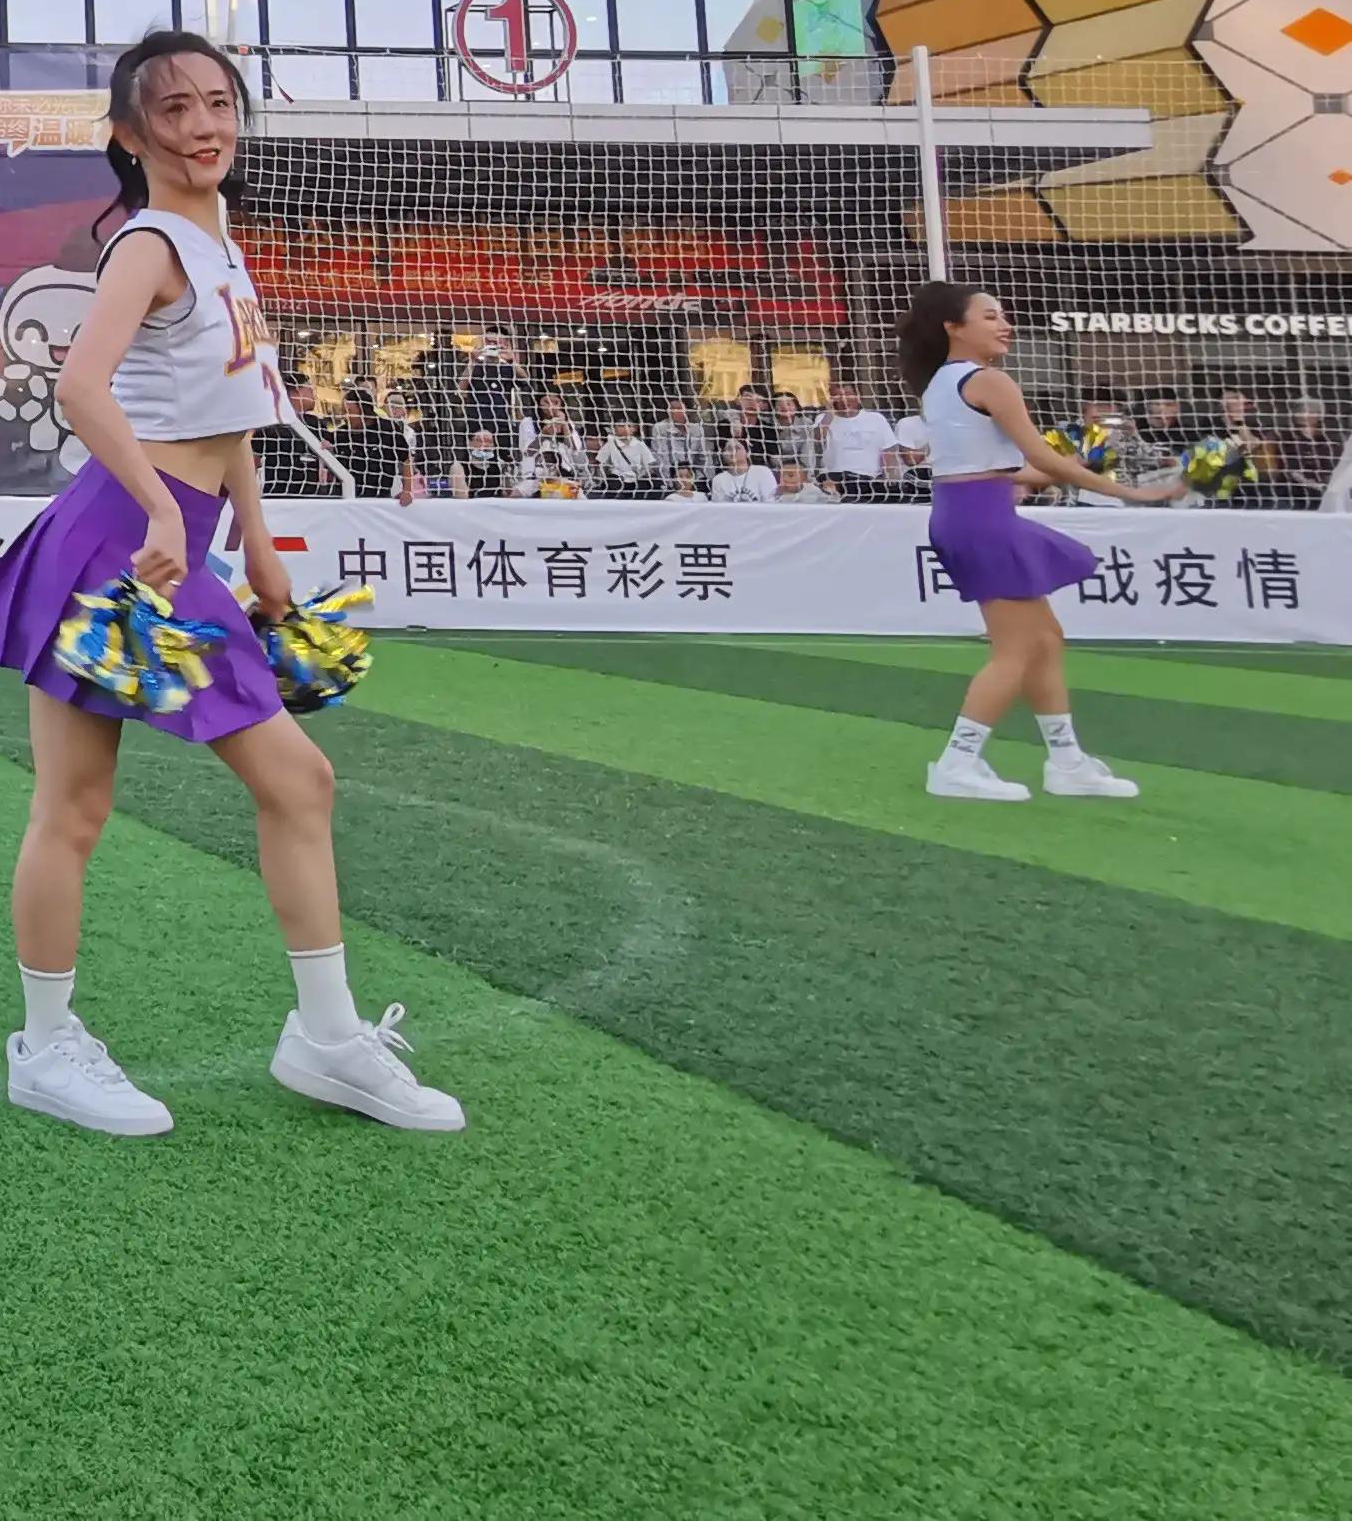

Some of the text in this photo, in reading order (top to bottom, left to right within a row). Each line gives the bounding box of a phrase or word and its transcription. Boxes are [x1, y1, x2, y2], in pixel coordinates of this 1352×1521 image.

[1050, 311, 1239, 335] STARBUCKS
[338, 538, 734, 600] 中国体育彩票
